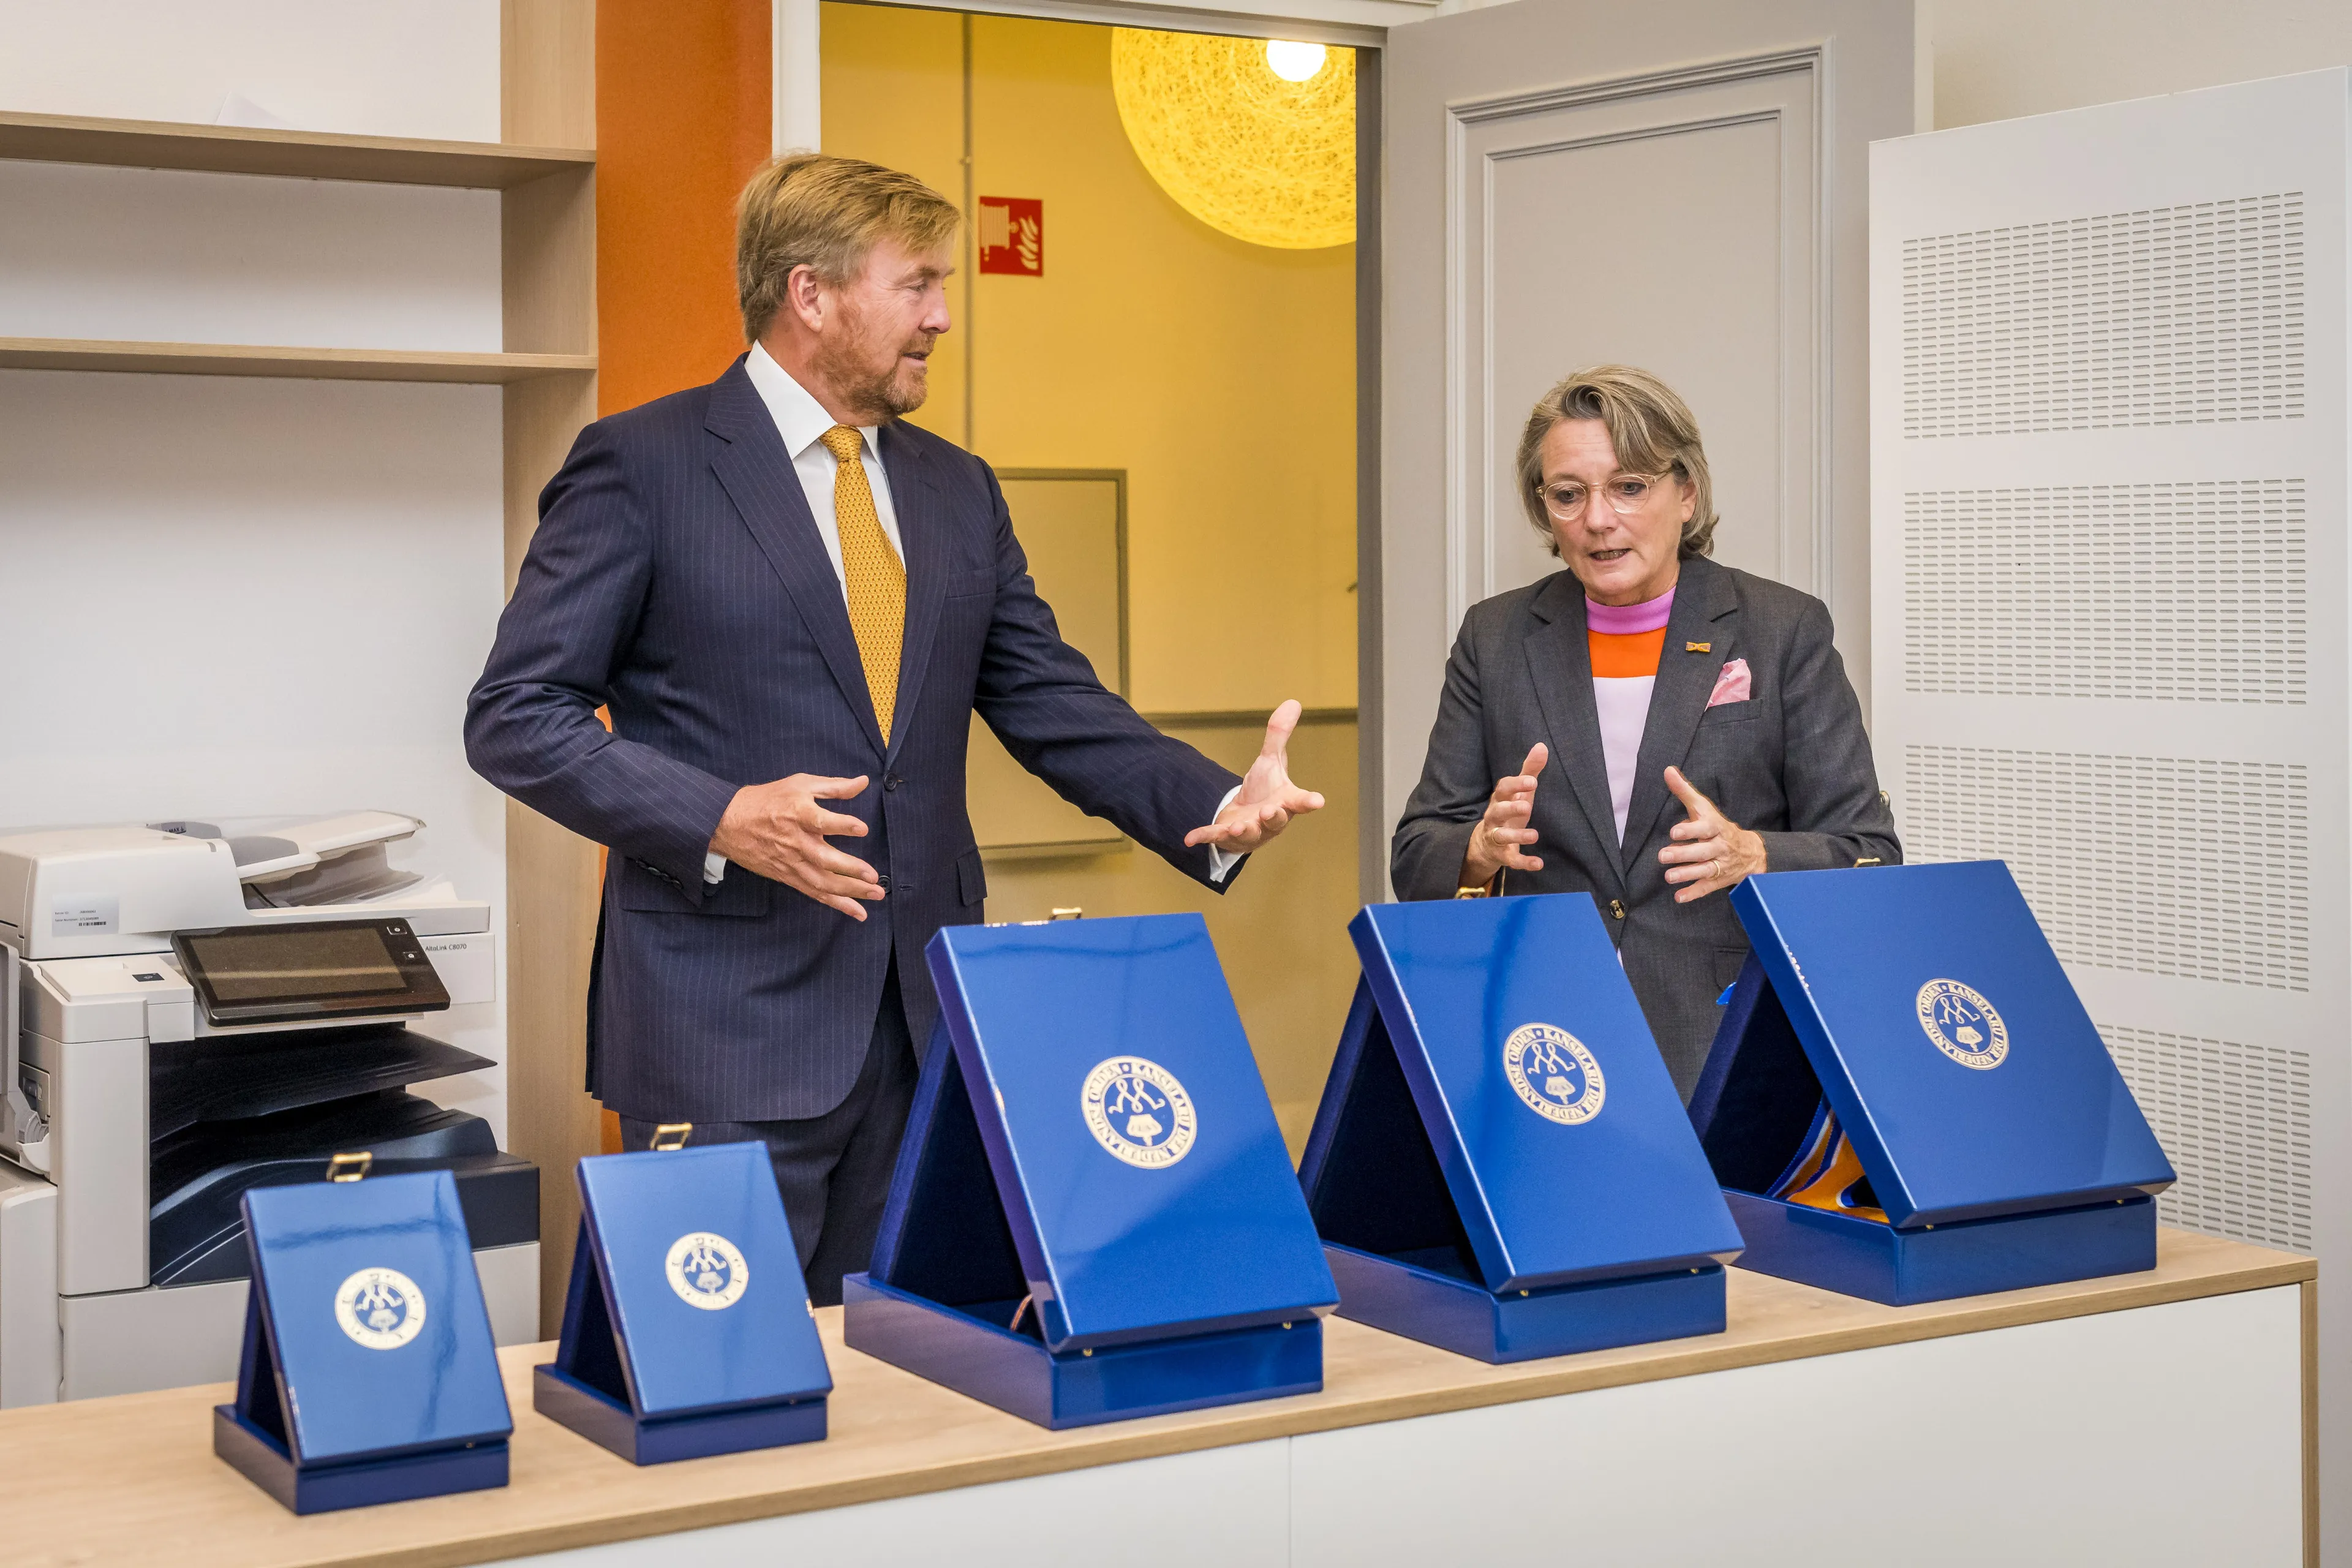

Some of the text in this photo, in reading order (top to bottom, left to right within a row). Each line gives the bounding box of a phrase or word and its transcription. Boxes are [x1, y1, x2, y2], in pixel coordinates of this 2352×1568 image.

[1921, 984, 1942, 1013] ORDEN
[1989, 1036, 2003, 1058] DER
[1581, 1088, 1599, 1112] DER
